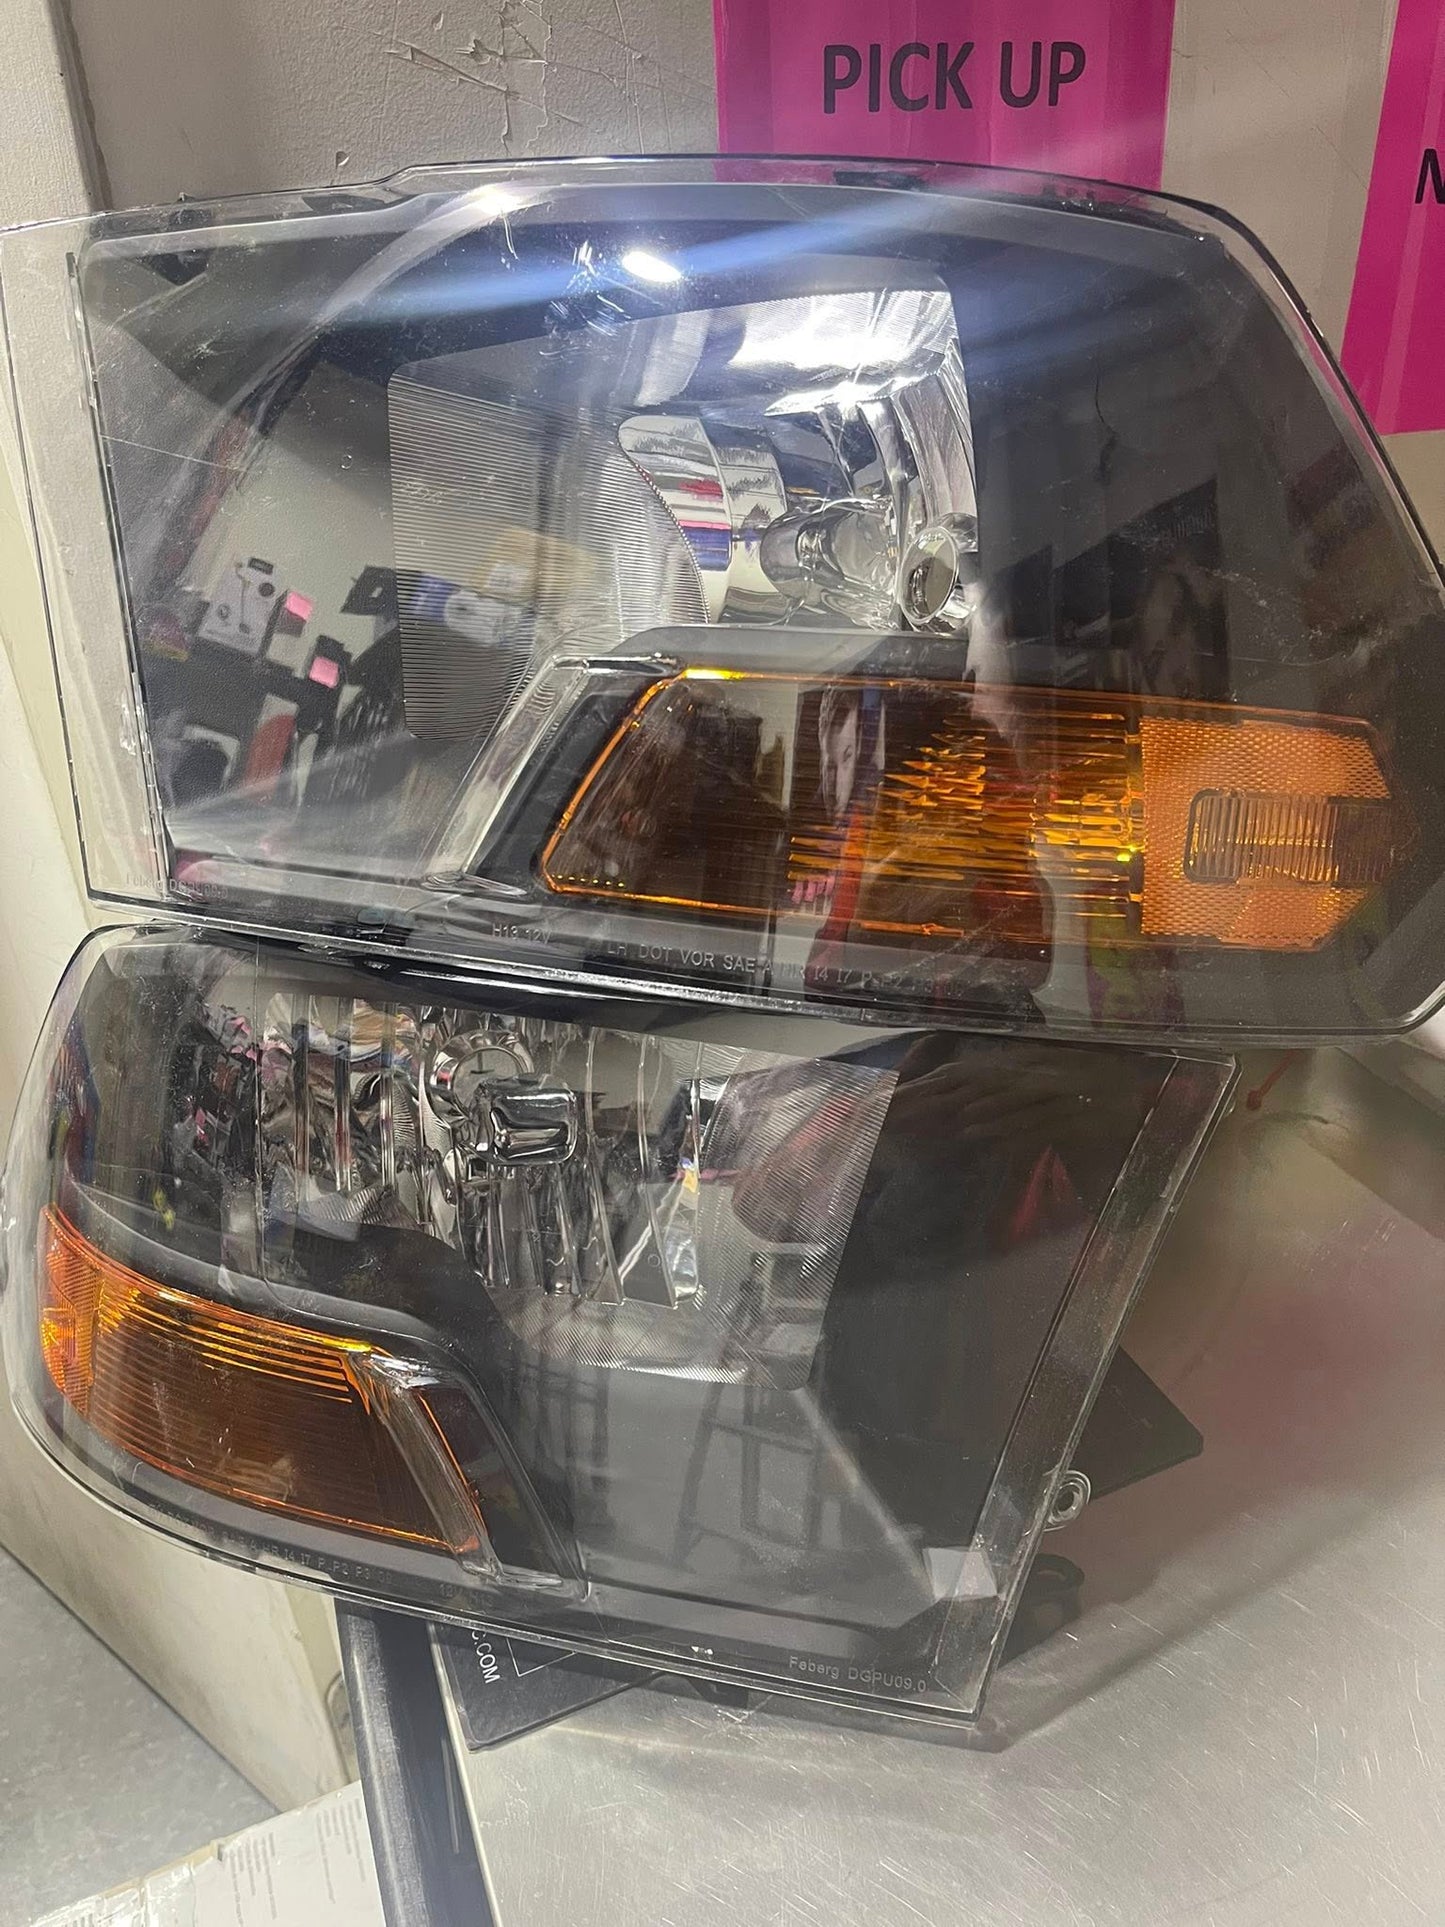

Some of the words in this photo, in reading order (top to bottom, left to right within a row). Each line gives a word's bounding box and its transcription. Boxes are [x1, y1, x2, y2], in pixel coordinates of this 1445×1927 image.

[824, 42, 974, 114] PICK
[1000, 41, 1086, 108] UP
[639, 943, 672, 963] DOT
[680, 949, 715, 968] VOR
[723, 954, 756, 974] SAE
[848, 1667, 927, 1693] DGPU09.0
